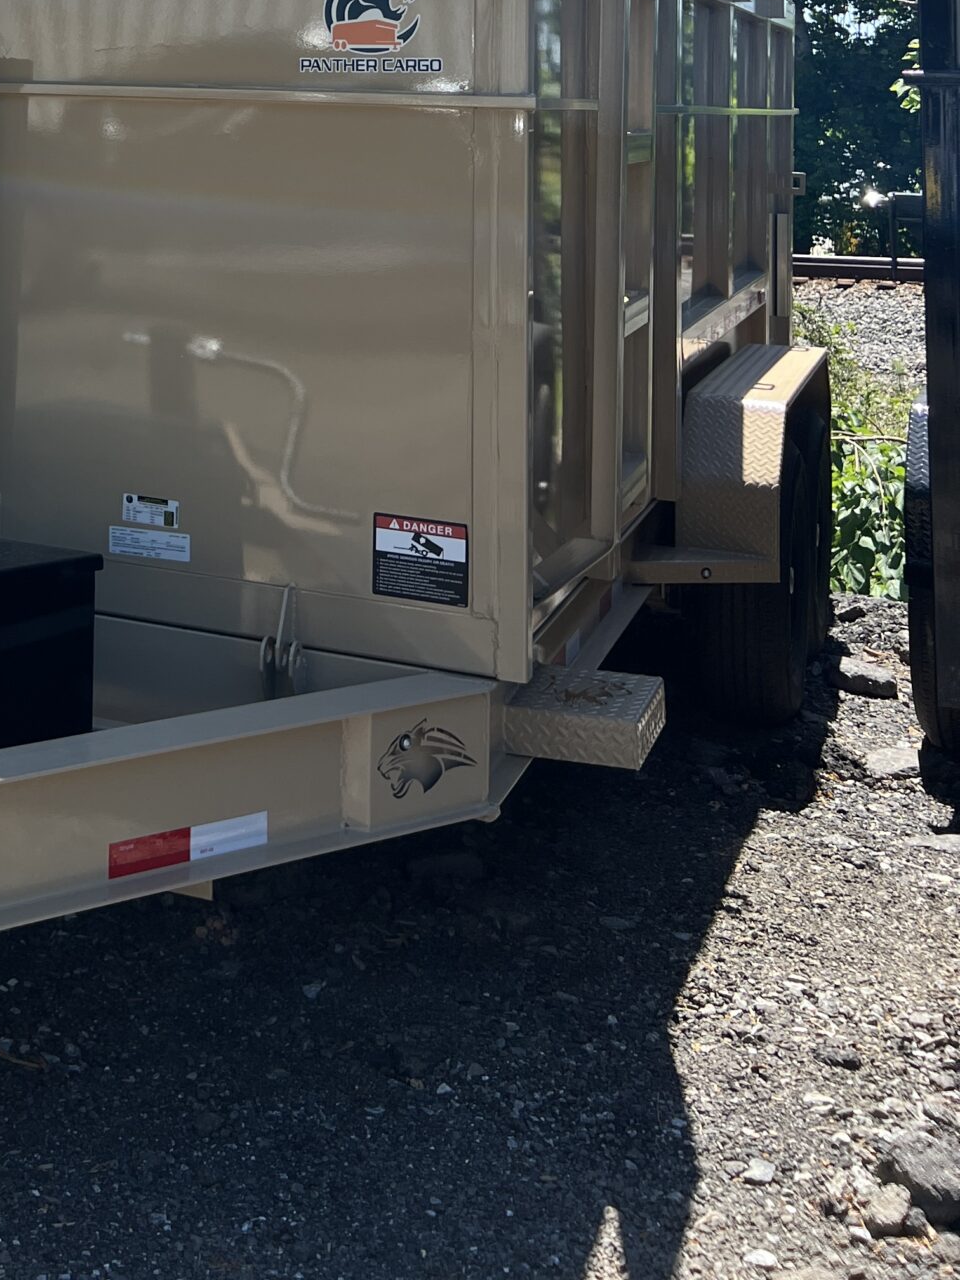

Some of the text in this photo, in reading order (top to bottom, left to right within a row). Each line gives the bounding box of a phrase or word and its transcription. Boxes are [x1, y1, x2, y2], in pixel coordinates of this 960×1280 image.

[300, 58, 442, 73] PANTHER CARGO
[403, 521, 453, 536] DANGER
